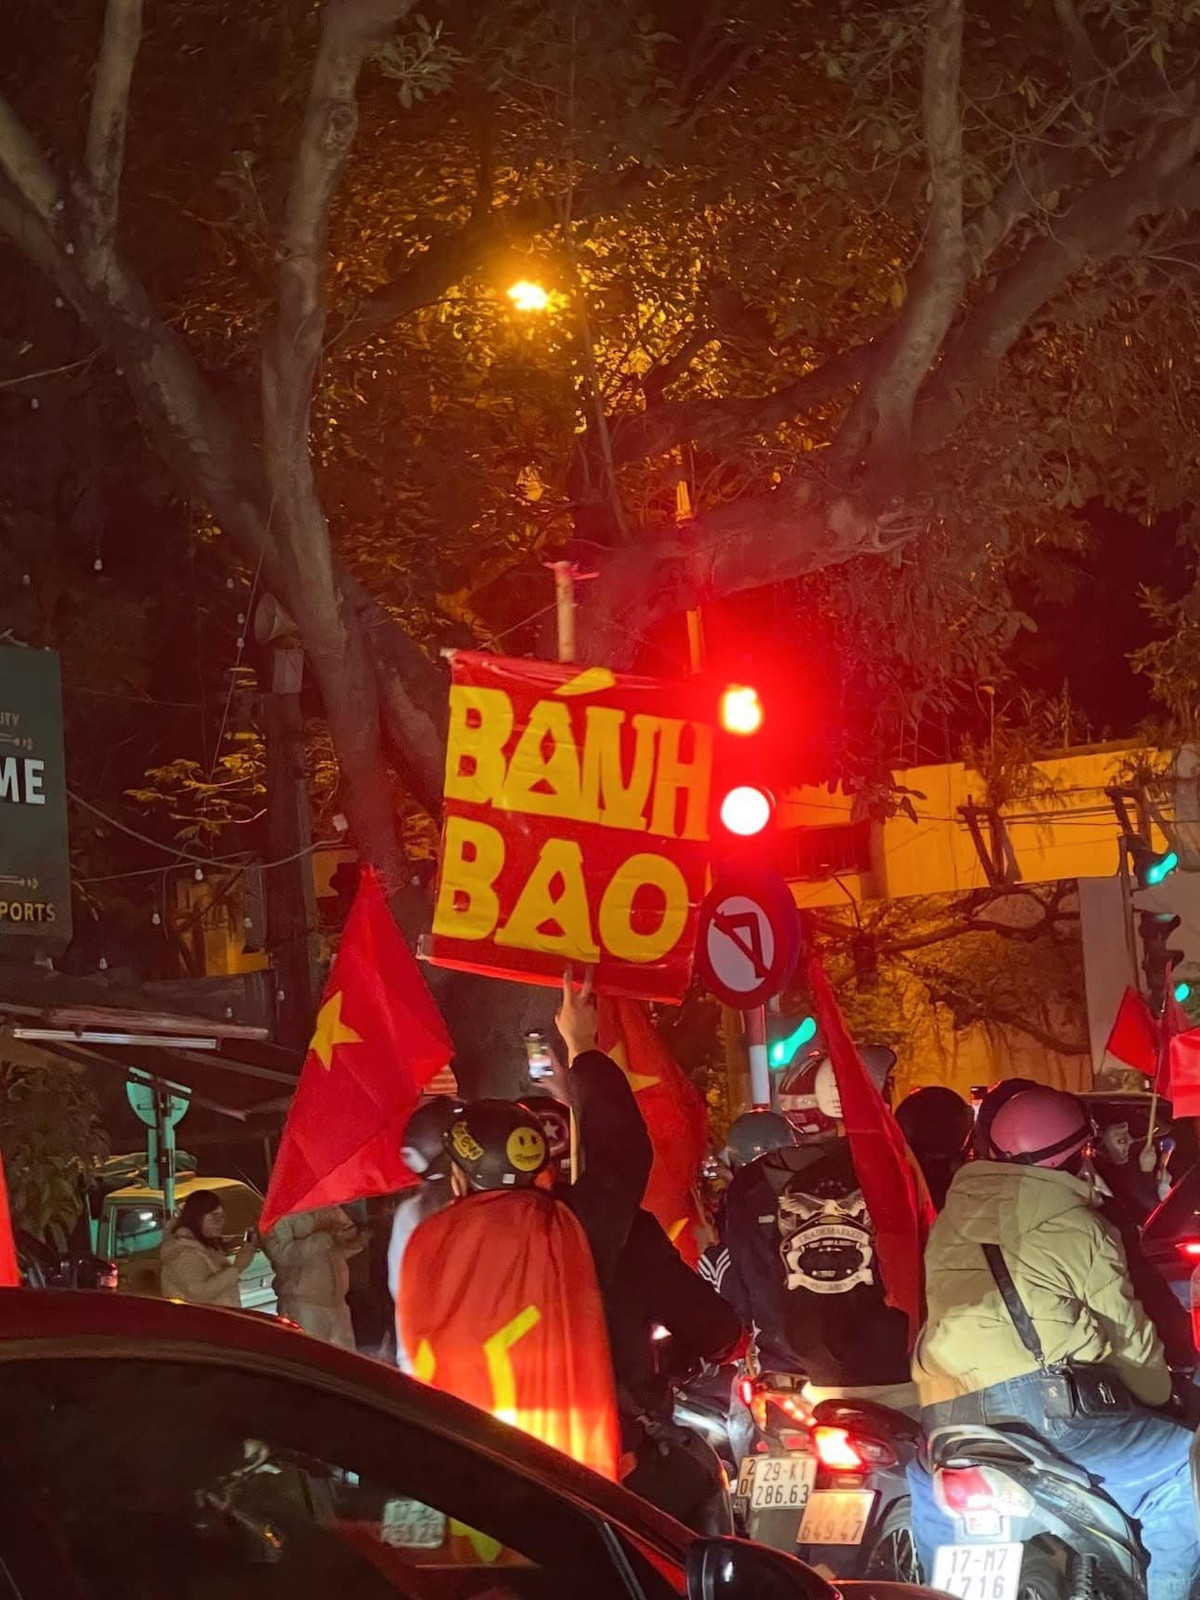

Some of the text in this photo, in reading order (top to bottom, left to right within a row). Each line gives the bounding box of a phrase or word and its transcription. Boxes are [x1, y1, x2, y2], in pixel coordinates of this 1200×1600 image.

[444, 667, 713, 841] BÁNH
[0, 757, 46, 805] ME
[432, 816, 689, 963] BAO
[0, 901, 56, 921] PORTS
[763, 1462, 807, 1482] 29-K1
[755, 1484, 809, 1506] 286.63
[951, 1548, 1008, 1573] 17-M7
